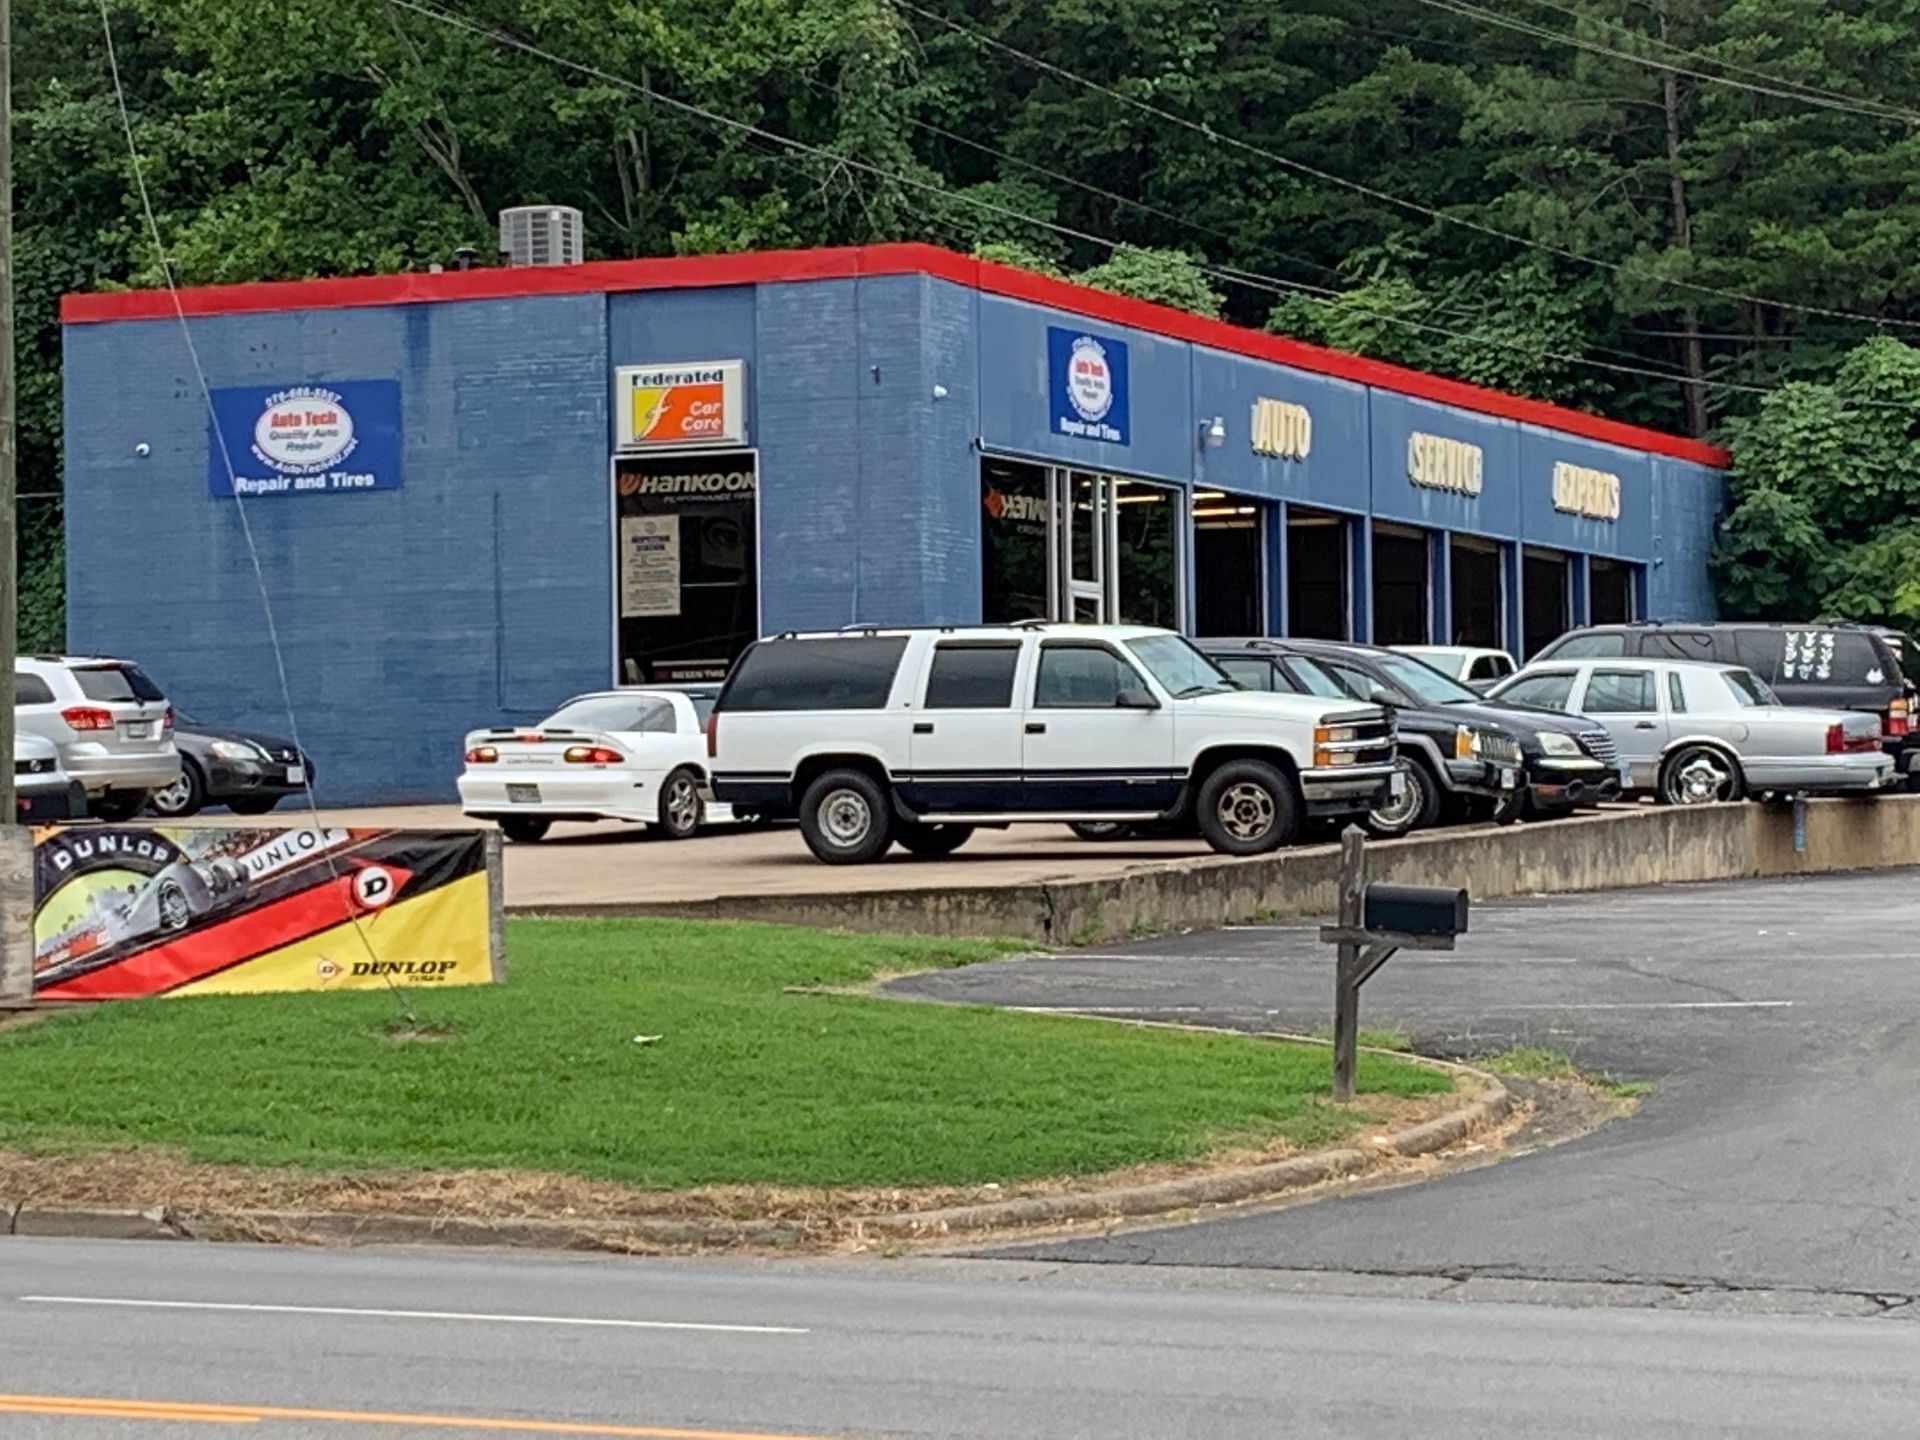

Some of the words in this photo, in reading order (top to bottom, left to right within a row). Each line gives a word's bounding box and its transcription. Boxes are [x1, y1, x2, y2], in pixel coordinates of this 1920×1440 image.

[632, 369, 723, 386] Federated
[690, 401, 722, 416] Car
[271, 413, 302, 427] Auto
[305, 410, 337, 426] Tech
[681, 415, 722, 431] Care
[1251, 396, 1311, 458] AUTO
[269, 430, 309, 441] Quality
[313, 429, 339, 438] Auto
[286, 441, 323, 452] Repair
[1408, 431, 1482, 494] SERVICE
[236, 476, 291, 495] Repair
[294, 474, 326, 489] and
[329, 472, 375, 487] Tires
[1553, 461, 1620, 520] EXPERTS
[53, 836, 169, 870] DUNLOP
[251, 828, 332, 871] UNLOP
[364, 877, 387, 898] D
[351, 961, 457, 976] DUNLOP
